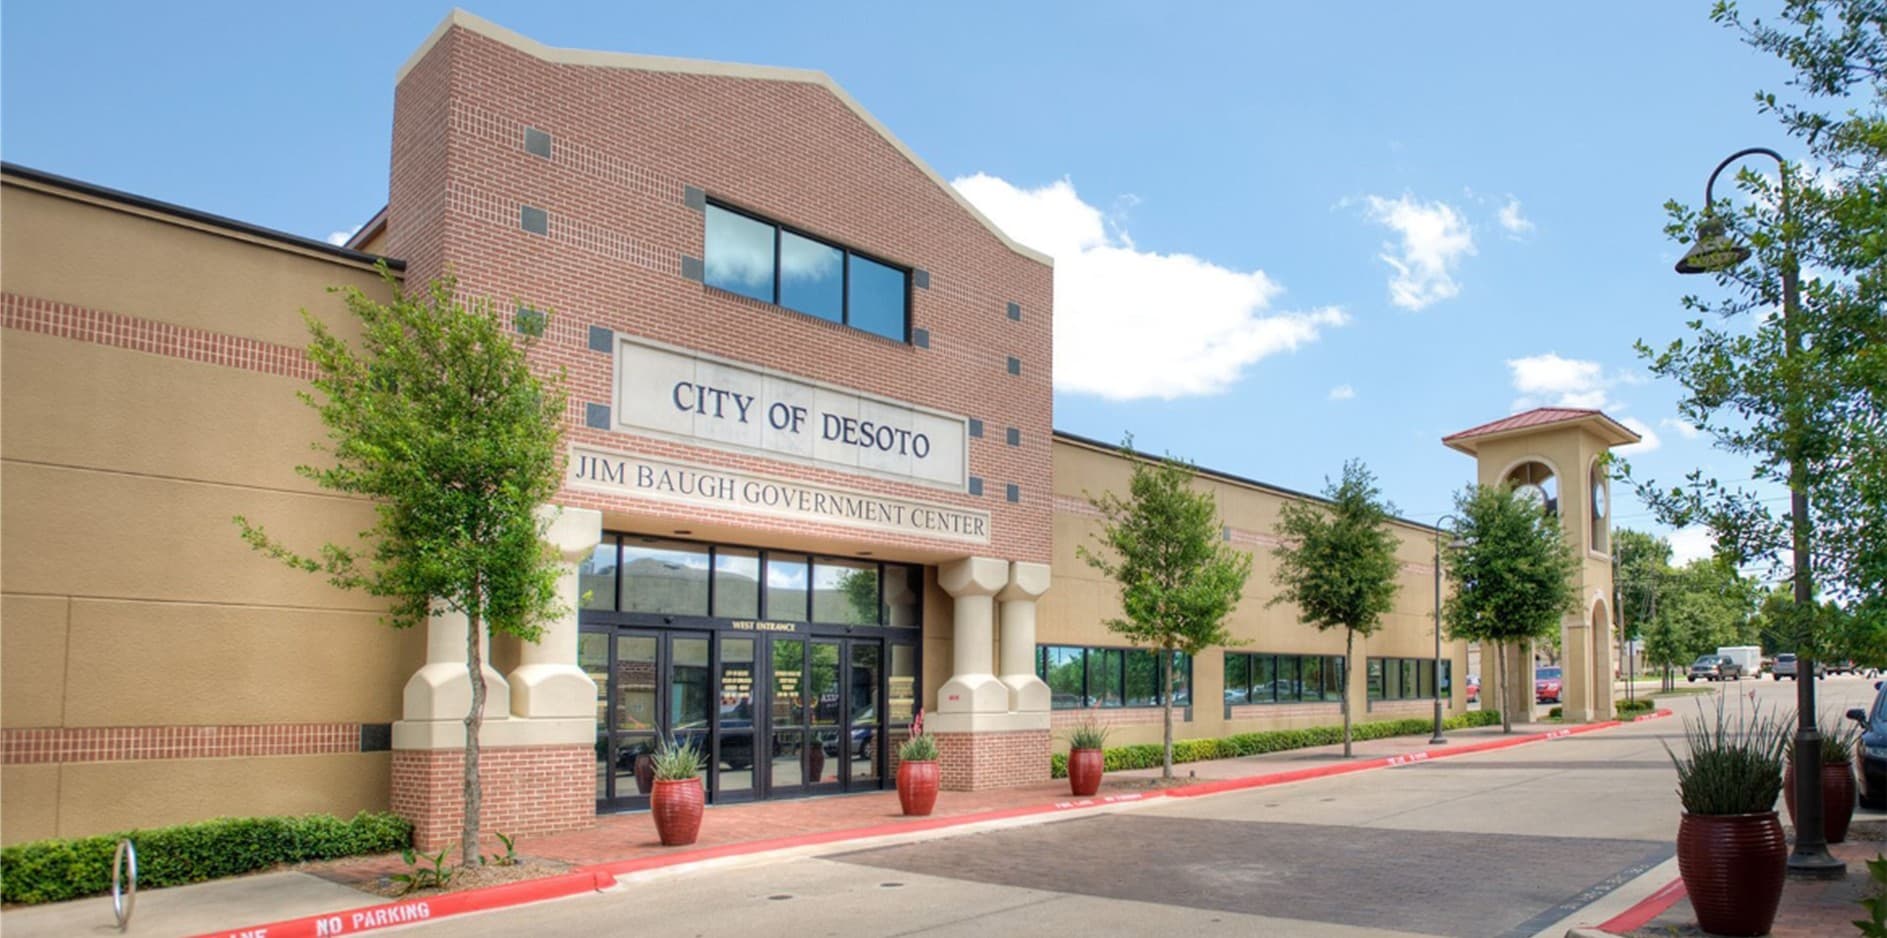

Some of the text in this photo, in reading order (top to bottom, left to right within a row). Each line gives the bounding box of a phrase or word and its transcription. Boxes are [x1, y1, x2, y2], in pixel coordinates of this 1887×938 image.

[673, 381, 931, 459] CITY OF DESOTO
[575, 455, 986, 537] JIM BAUGH GOVERNMENT CENTER
[731, 620, 797, 632] WEST ENTRANCE
[316, 915, 343, 937] NO
[352, 901, 431, 930] PARKING
